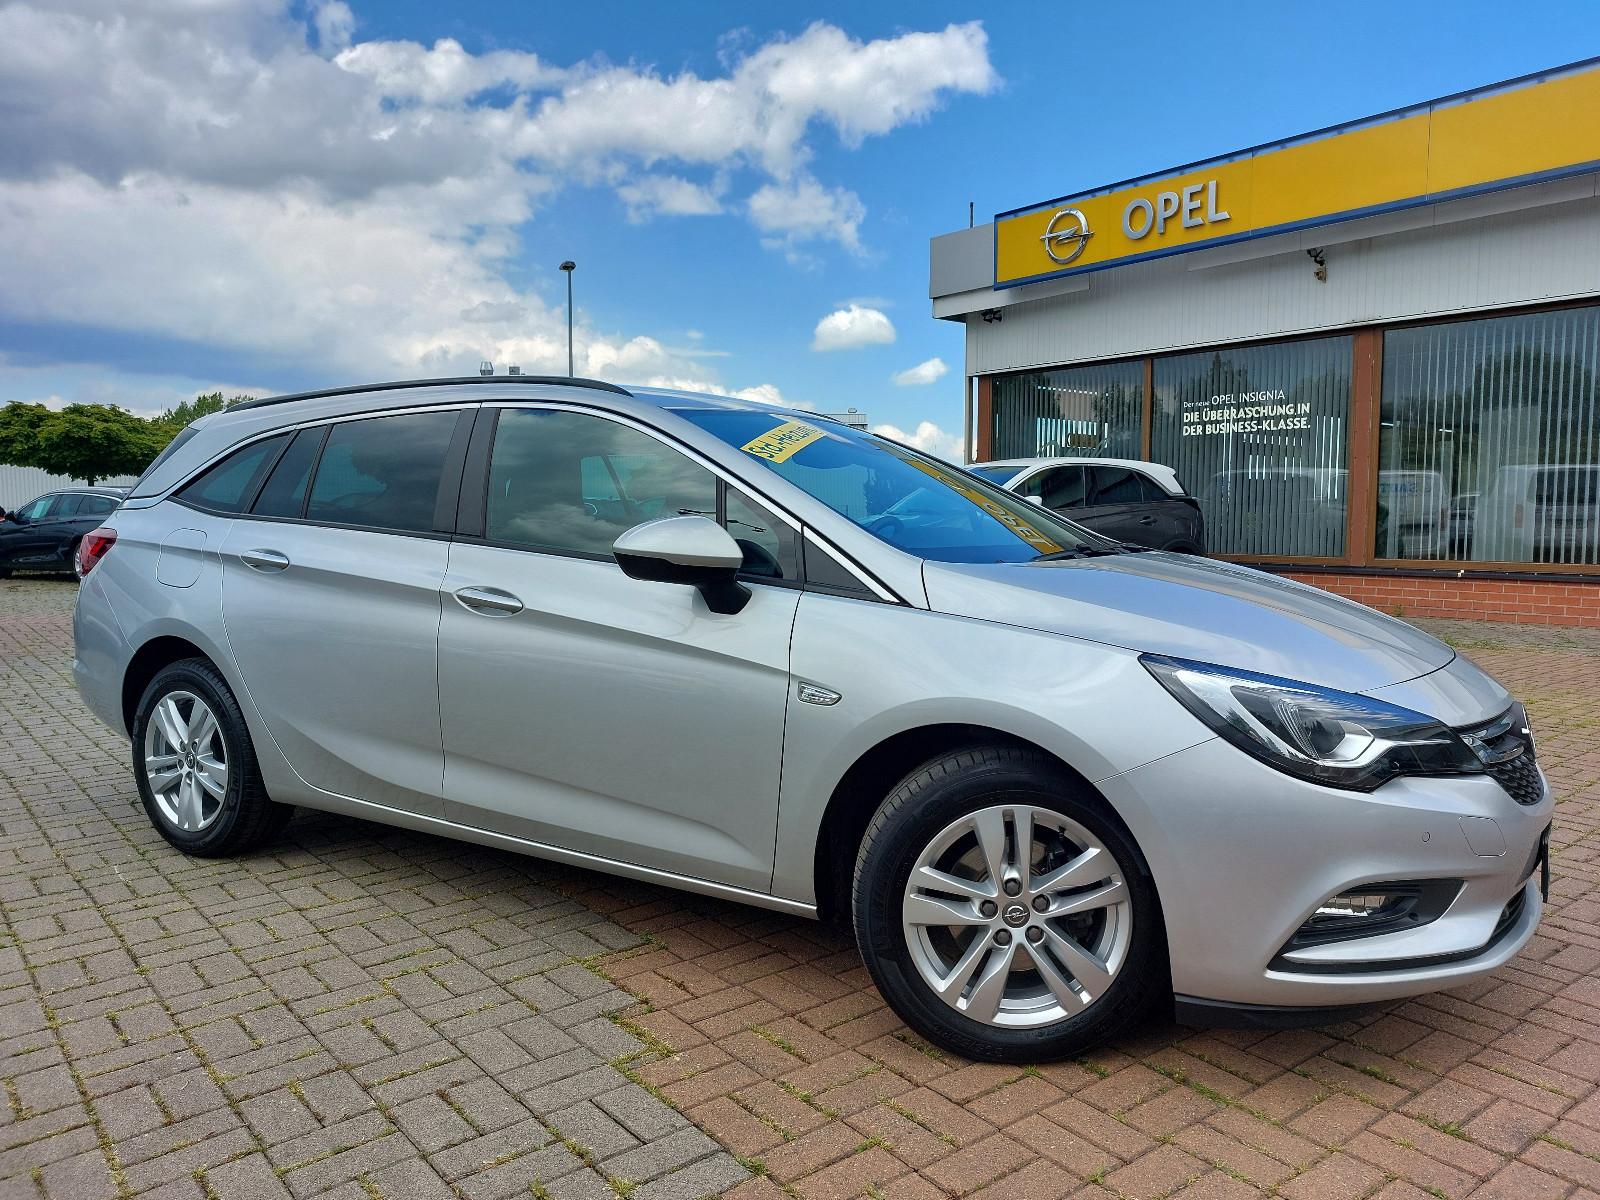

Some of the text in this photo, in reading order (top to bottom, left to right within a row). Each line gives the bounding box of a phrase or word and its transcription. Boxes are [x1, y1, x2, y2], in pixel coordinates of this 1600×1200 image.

[1122, 179, 1231, 240] OPEL
[1211, 394, 1237, 406] OPEL
[1239, 389, 1286, 403] INSIGNIA
[1183, 402, 1311, 423] DIE ÜBERRASCHUNG IN
[1183, 417, 1311, 436] DER BUSINESS-KLASSE.
